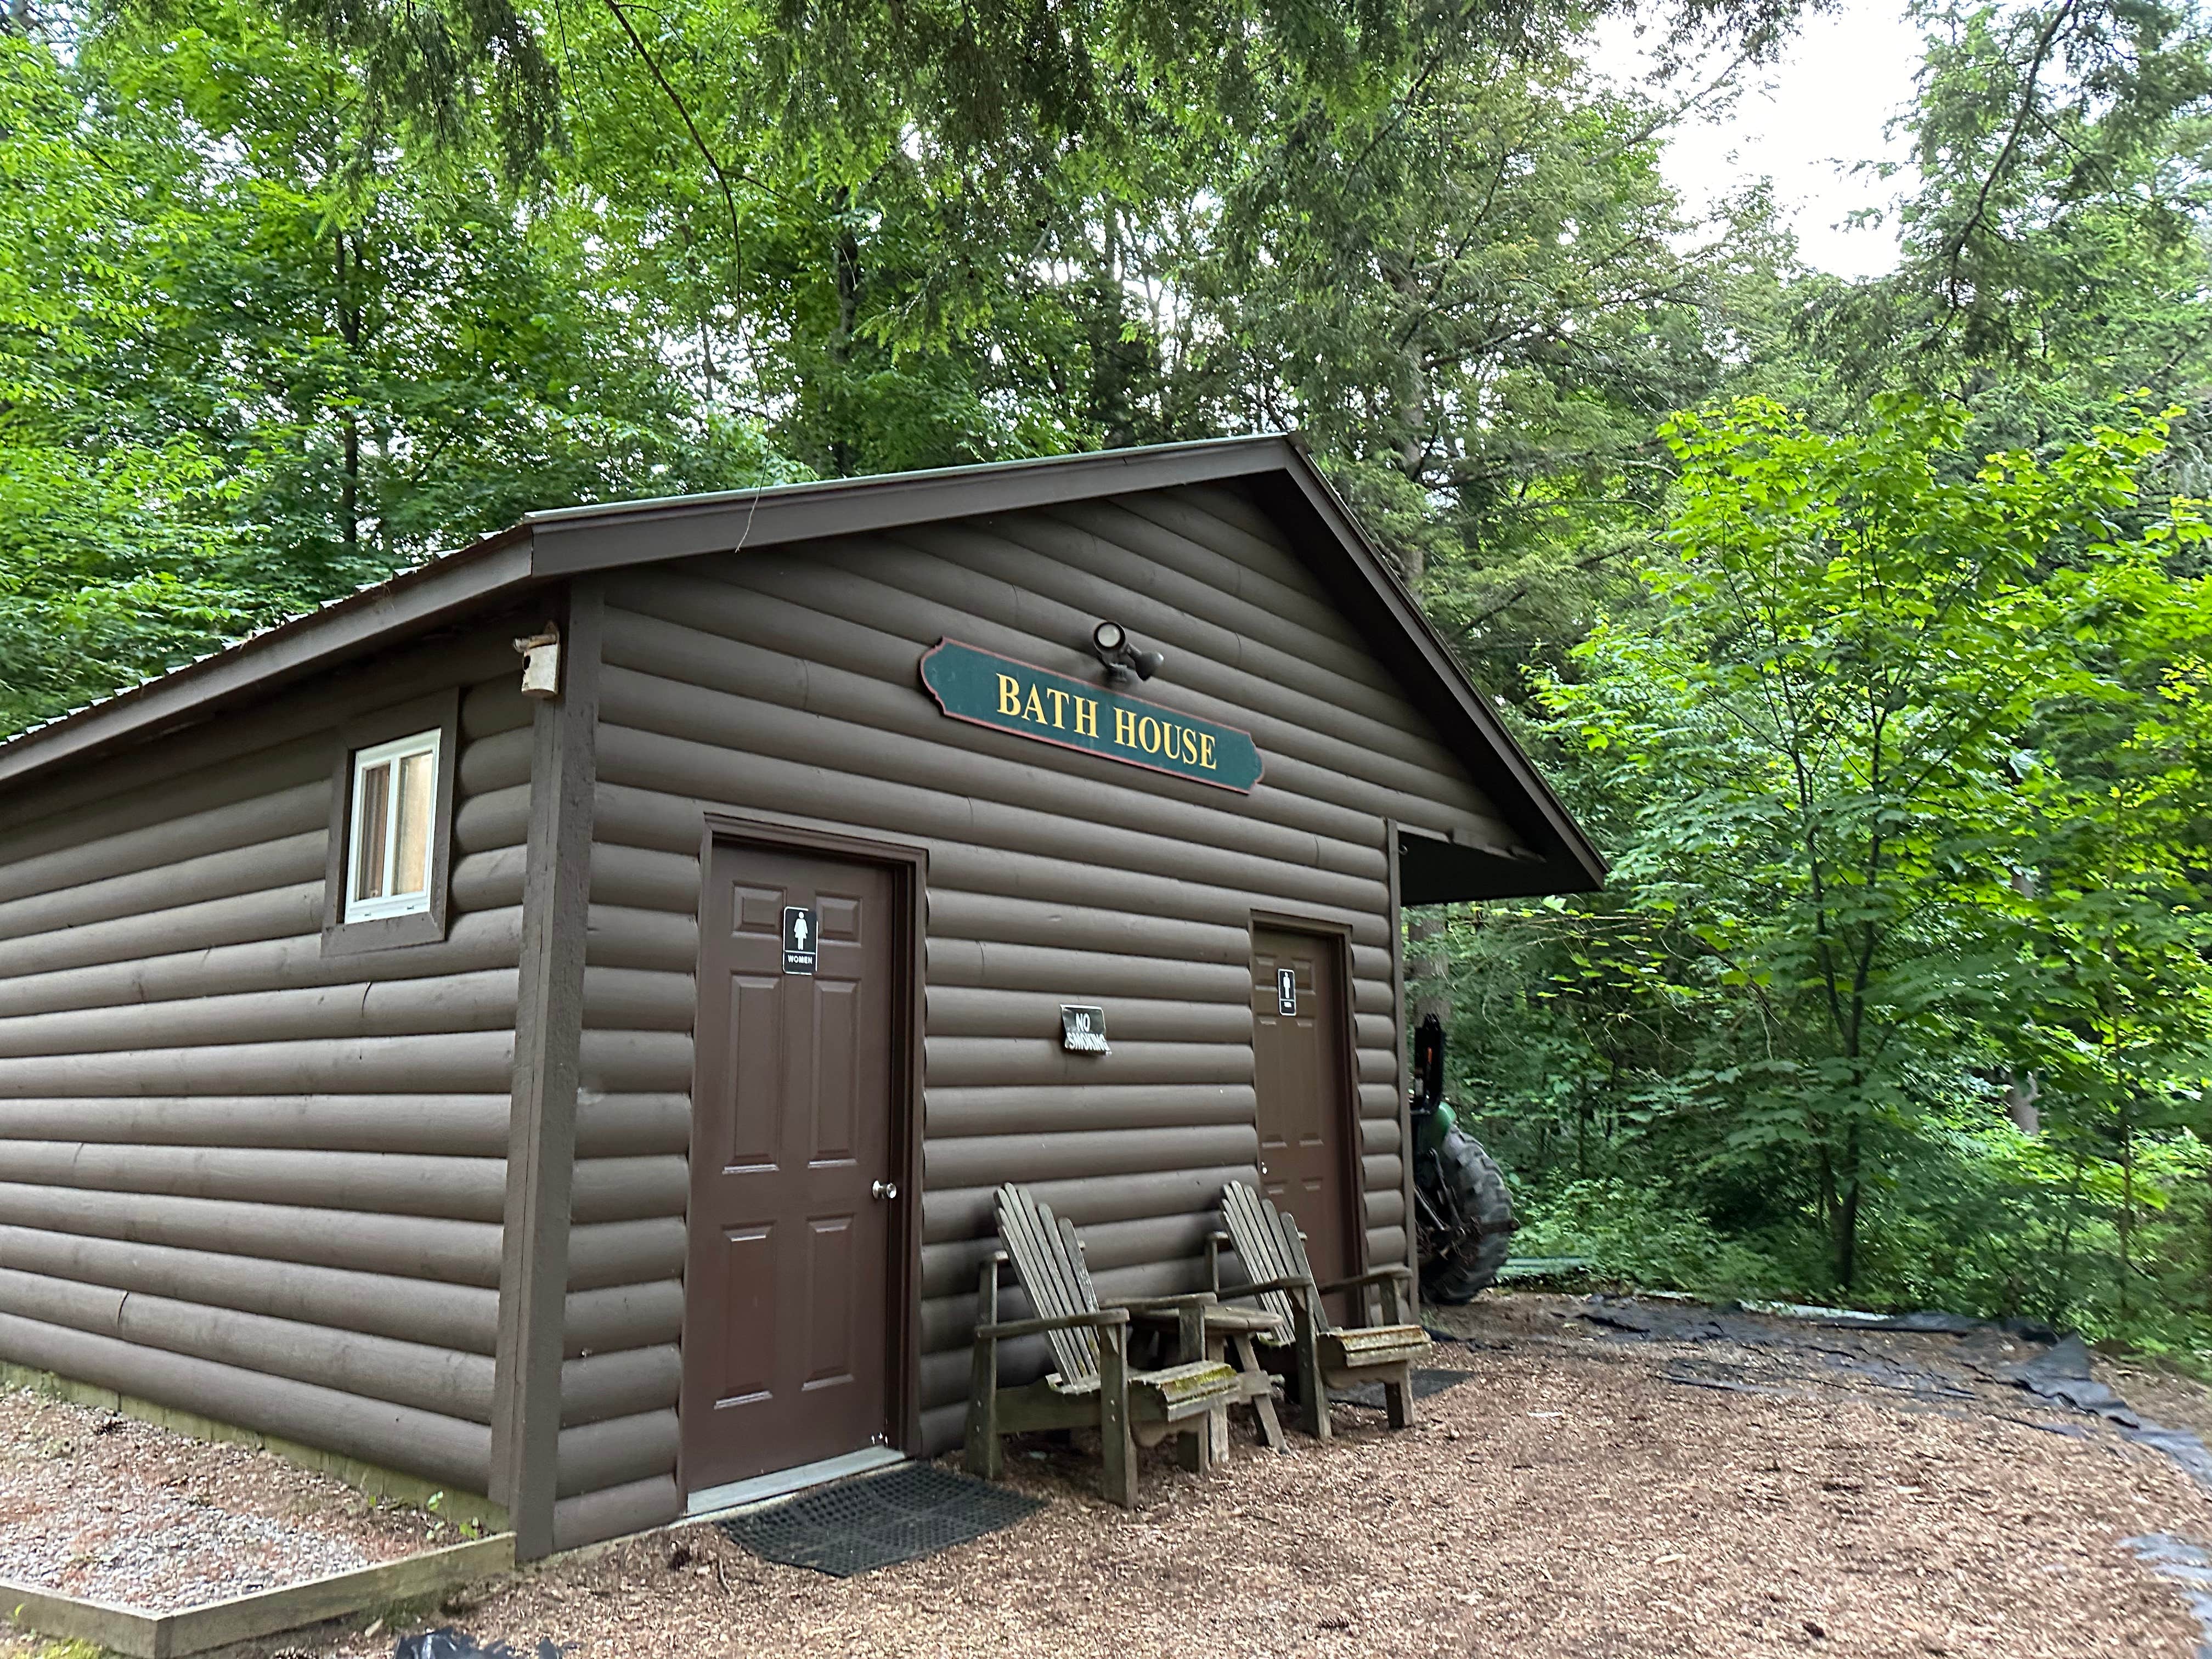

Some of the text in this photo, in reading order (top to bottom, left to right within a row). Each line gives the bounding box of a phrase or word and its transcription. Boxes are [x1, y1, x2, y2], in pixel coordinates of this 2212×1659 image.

[996, 673, 1217, 770] BATH HOUSE
[788, 955, 812, 964] WOMEN
[1076, 1013, 1091, 1032] NO
[1066, 1032, 1111, 1051] SMOKING
